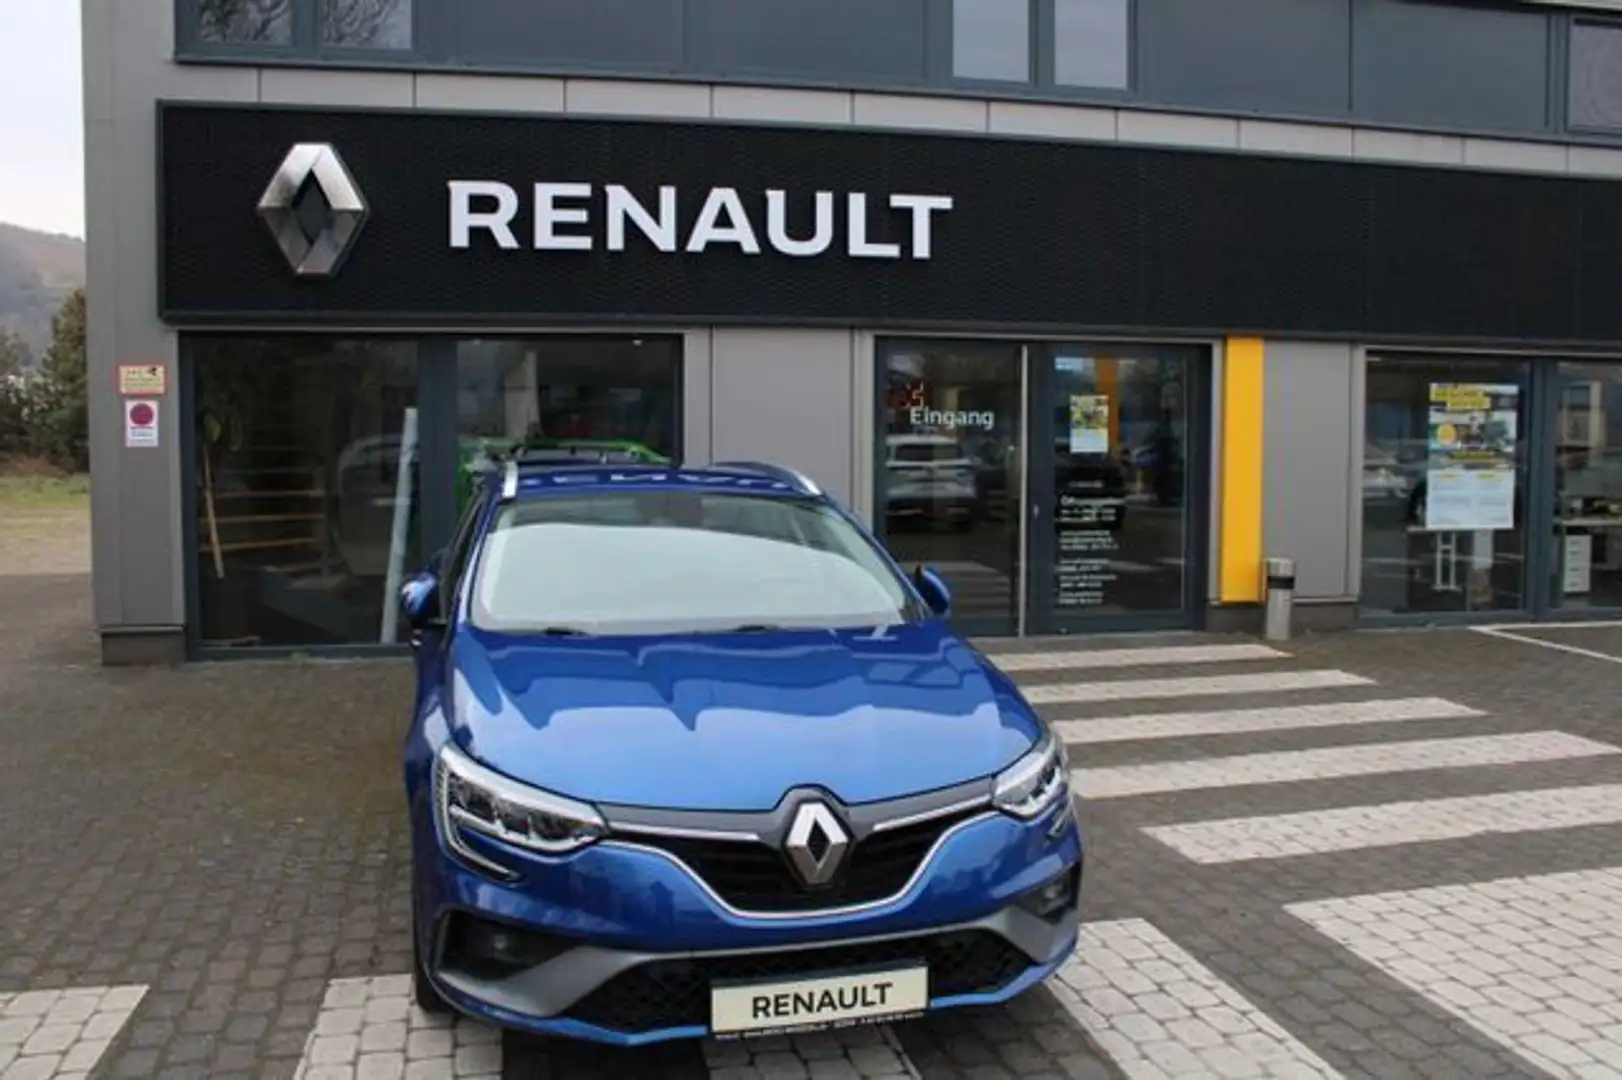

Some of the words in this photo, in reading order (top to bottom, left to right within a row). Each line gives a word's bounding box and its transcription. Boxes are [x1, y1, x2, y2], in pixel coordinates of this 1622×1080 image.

[448, 180, 953, 259] RENAULT
[909, 408, 995, 431] Eingang
[752, 982, 893, 1019] RENAULT
